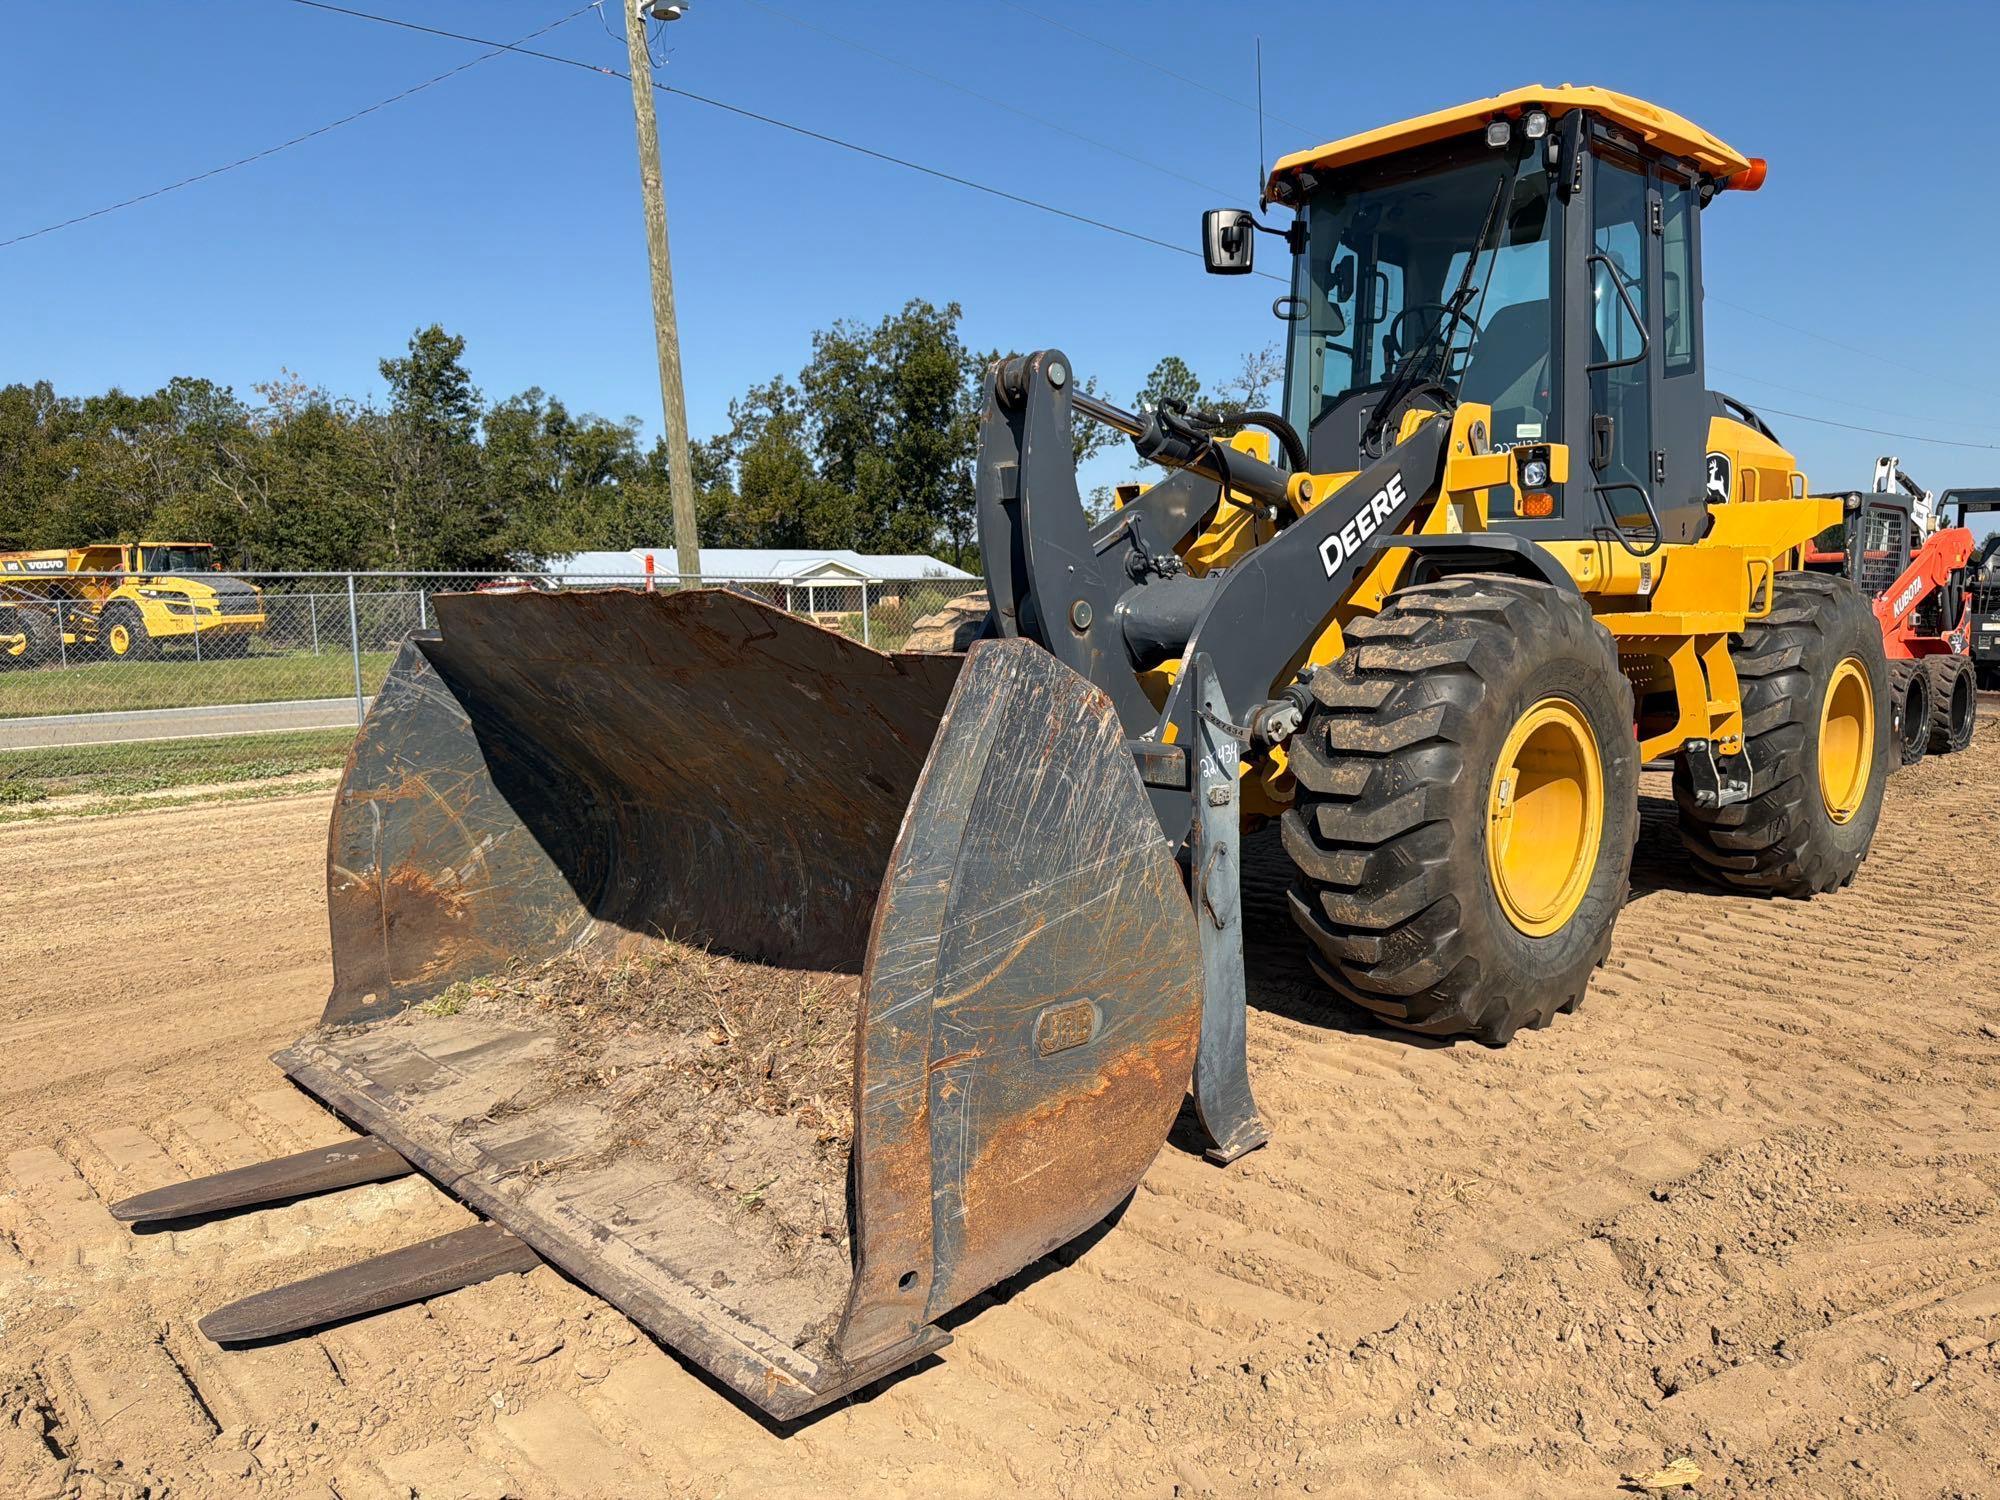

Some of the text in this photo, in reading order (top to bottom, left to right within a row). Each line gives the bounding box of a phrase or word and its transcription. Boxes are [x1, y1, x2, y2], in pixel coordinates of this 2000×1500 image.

[1318, 472, 1407, 578] DEERE
[27, 560, 64, 570] VOLVO
[1893, 575, 1922, 618] KUBOTA
[1200, 741, 1238, 778] 22434
